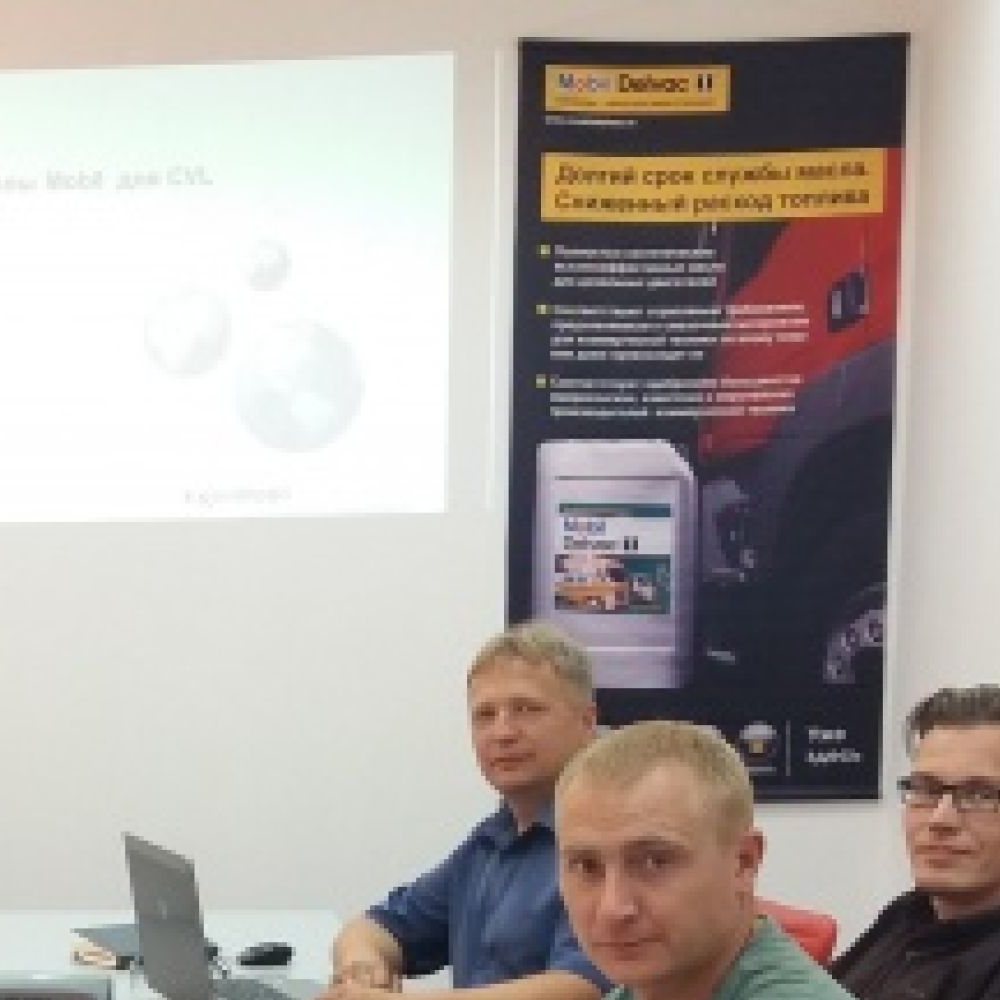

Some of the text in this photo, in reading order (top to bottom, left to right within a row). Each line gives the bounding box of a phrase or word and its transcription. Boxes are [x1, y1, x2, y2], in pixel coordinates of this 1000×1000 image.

[618, 73, 690, 93] Delvac
[642, 166, 694, 189] срок
[702, 162, 791, 189] службы
